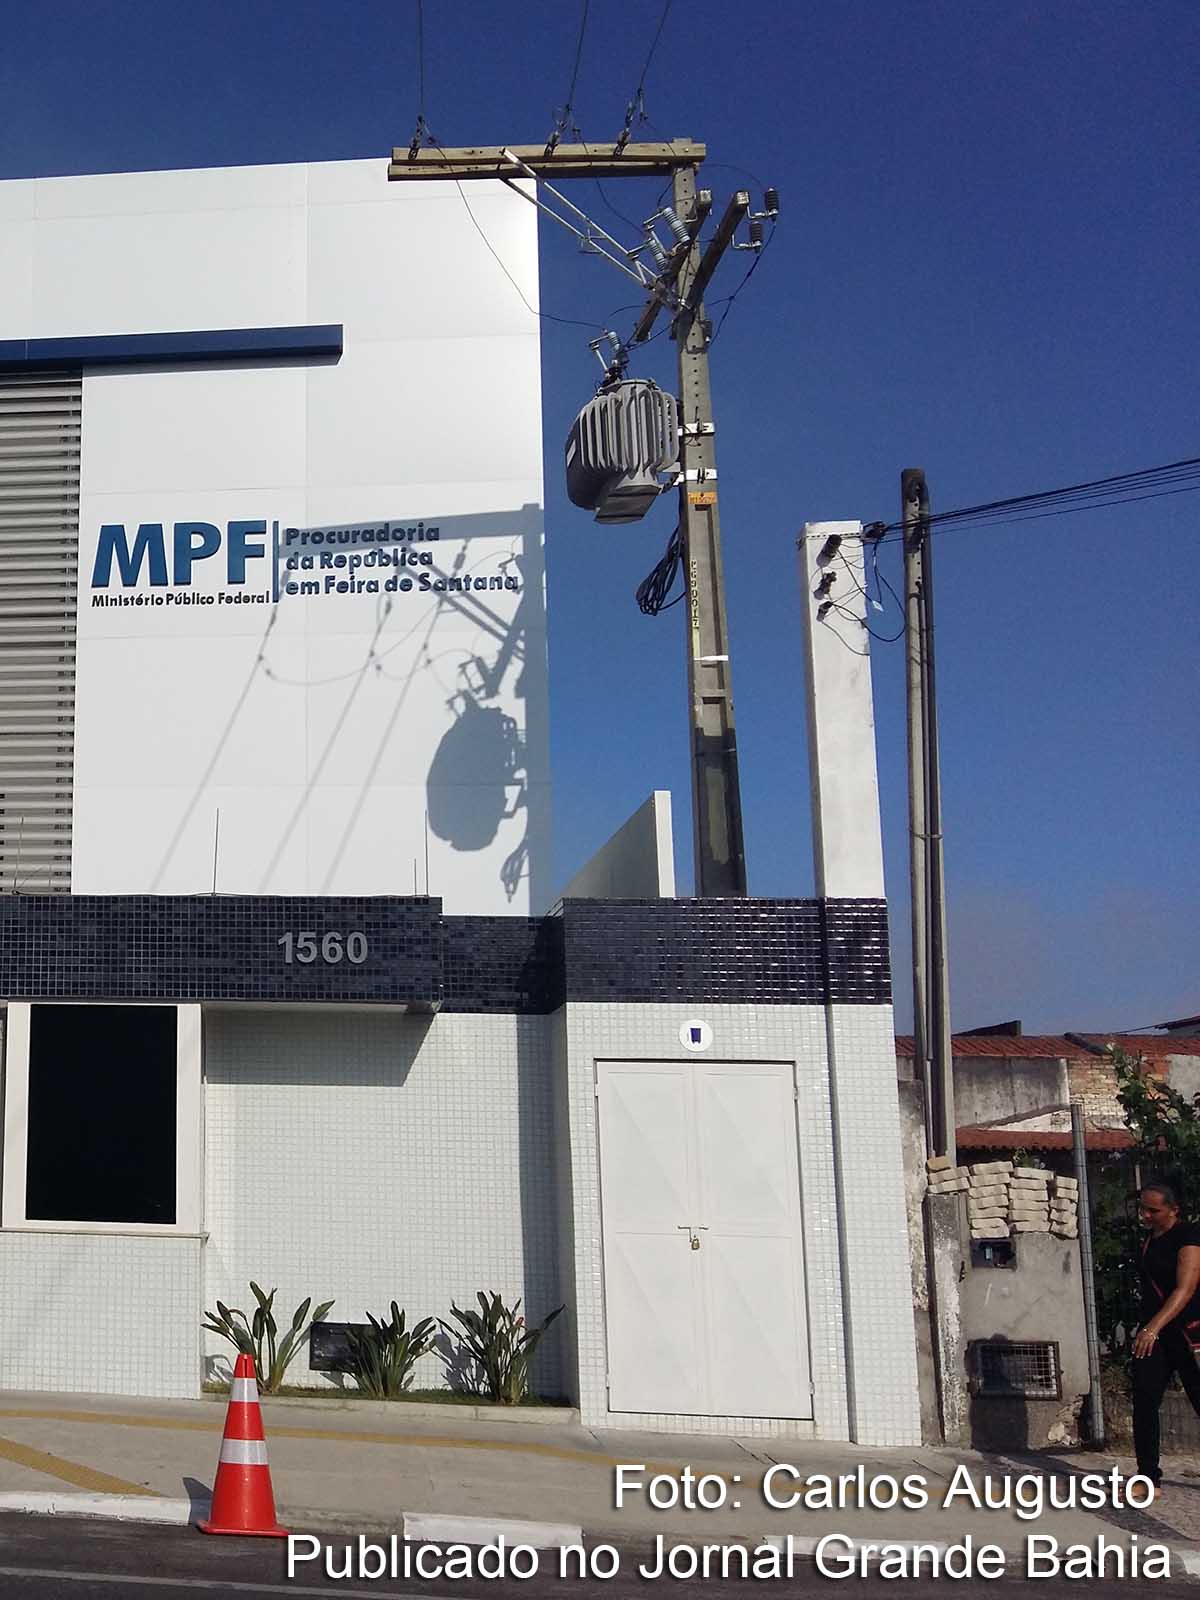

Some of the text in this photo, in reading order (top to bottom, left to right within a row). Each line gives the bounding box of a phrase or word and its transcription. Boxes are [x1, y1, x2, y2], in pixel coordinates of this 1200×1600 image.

[285, 522, 440, 546] Procuradoria
[91, 520, 267, 588] MPF
[286, 547, 434, 574] da República
[286, 573, 519, 595] em Feira de Santana
[91, 591, 270, 607] Ministério Público Federal
[278, 931, 368, 964] 1560
